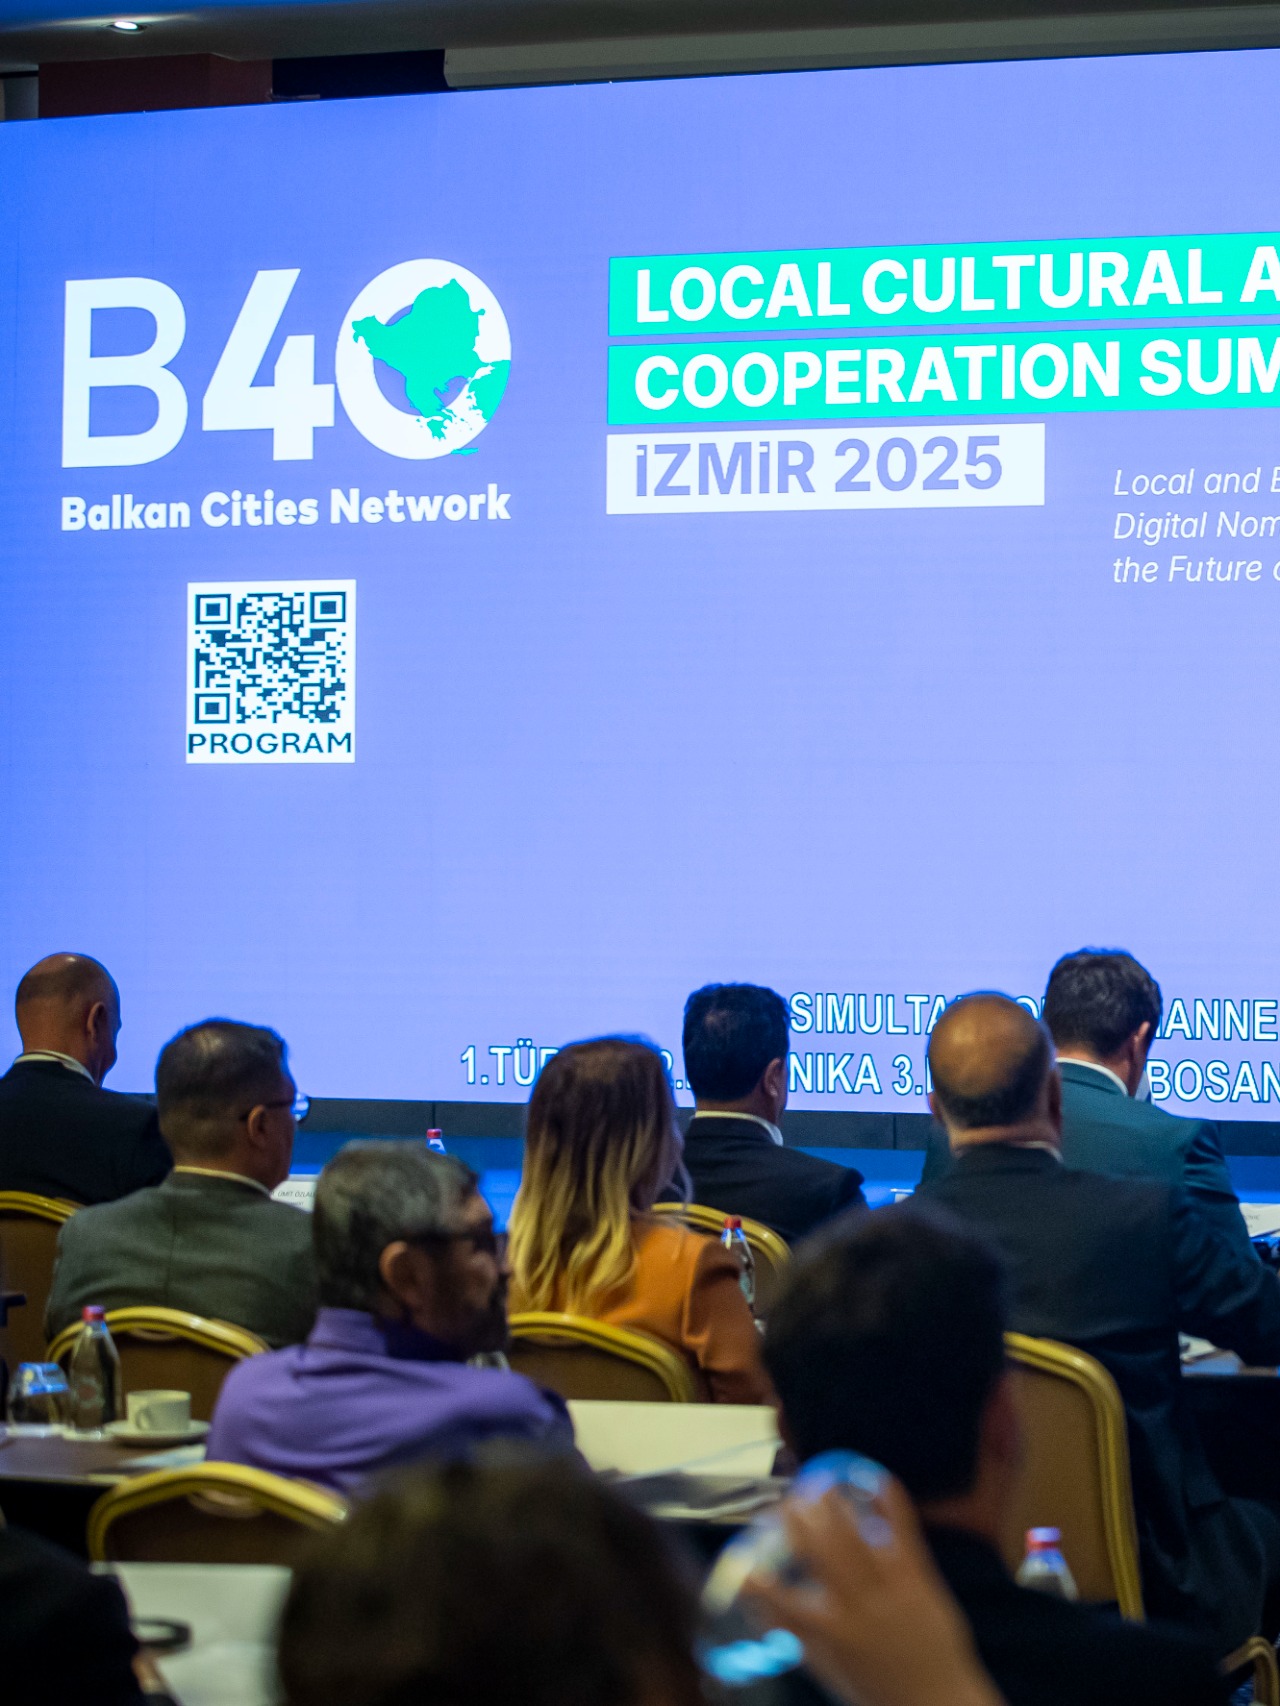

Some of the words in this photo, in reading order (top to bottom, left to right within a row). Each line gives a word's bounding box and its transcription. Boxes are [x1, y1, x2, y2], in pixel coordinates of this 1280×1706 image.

[636, 261, 851, 323] LOCAL
[861, 248, 1223, 314] CULTURAL
[61, 257, 512, 468] B40
[634, 340, 1121, 411] COOPERATION
[833, 434, 1003, 494] 2025
[1113, 468, 1195, 496] Local
[1203, 466, 1262, 495] and
[61, 493, 191, 531] Balkan
[200, 488, 319, 527] Cities
[330, 483, 512, 524] Network
[1113, 511, 1208, 546] Digital
[1113, 556, 1159, 583] the
[1168, 555, 1263, 582] Future
[187, 732, 353, 755] PROGRAM
